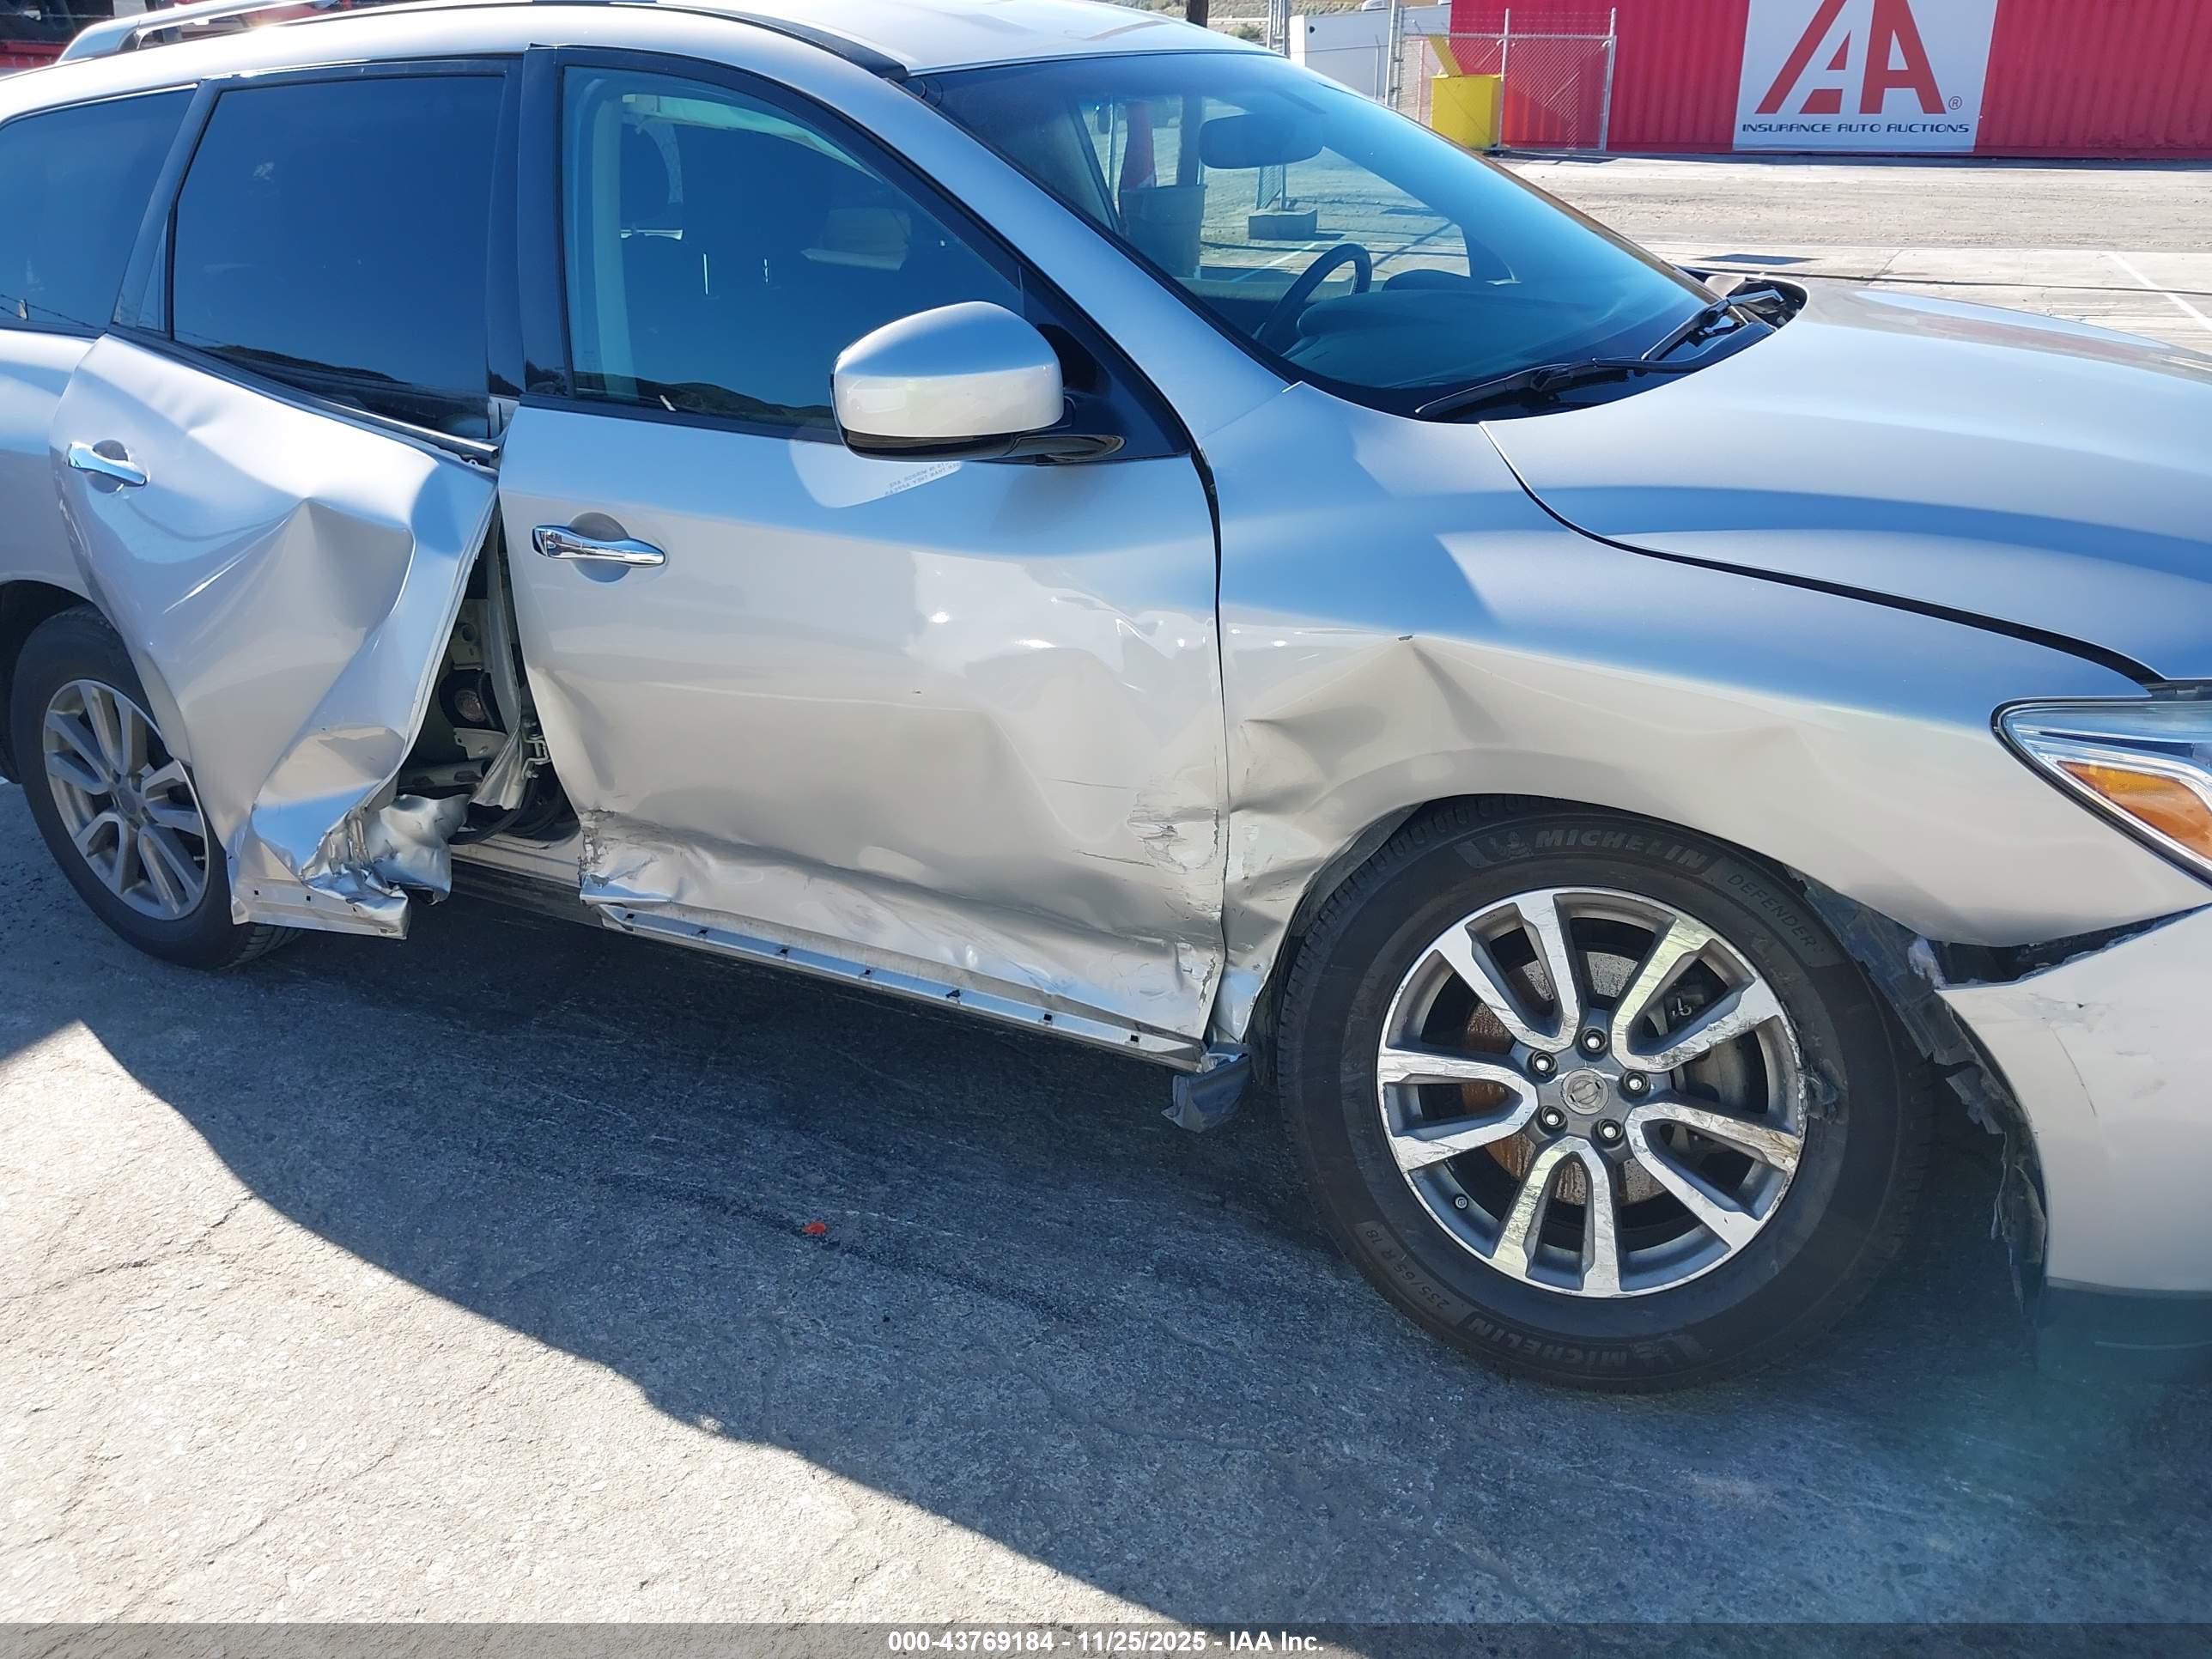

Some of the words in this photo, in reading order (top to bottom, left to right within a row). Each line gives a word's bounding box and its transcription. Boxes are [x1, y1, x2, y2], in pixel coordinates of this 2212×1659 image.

[1741, 123, 1832, 133] INSURANCE
[1837, 123, 1881, 133] AUTO
[1887, 123, 1970, 133] AUCTIONS
[1535, 829, 1708, 869] MICHELIN
[1728, 873, 1817, 947] DEFENDER
